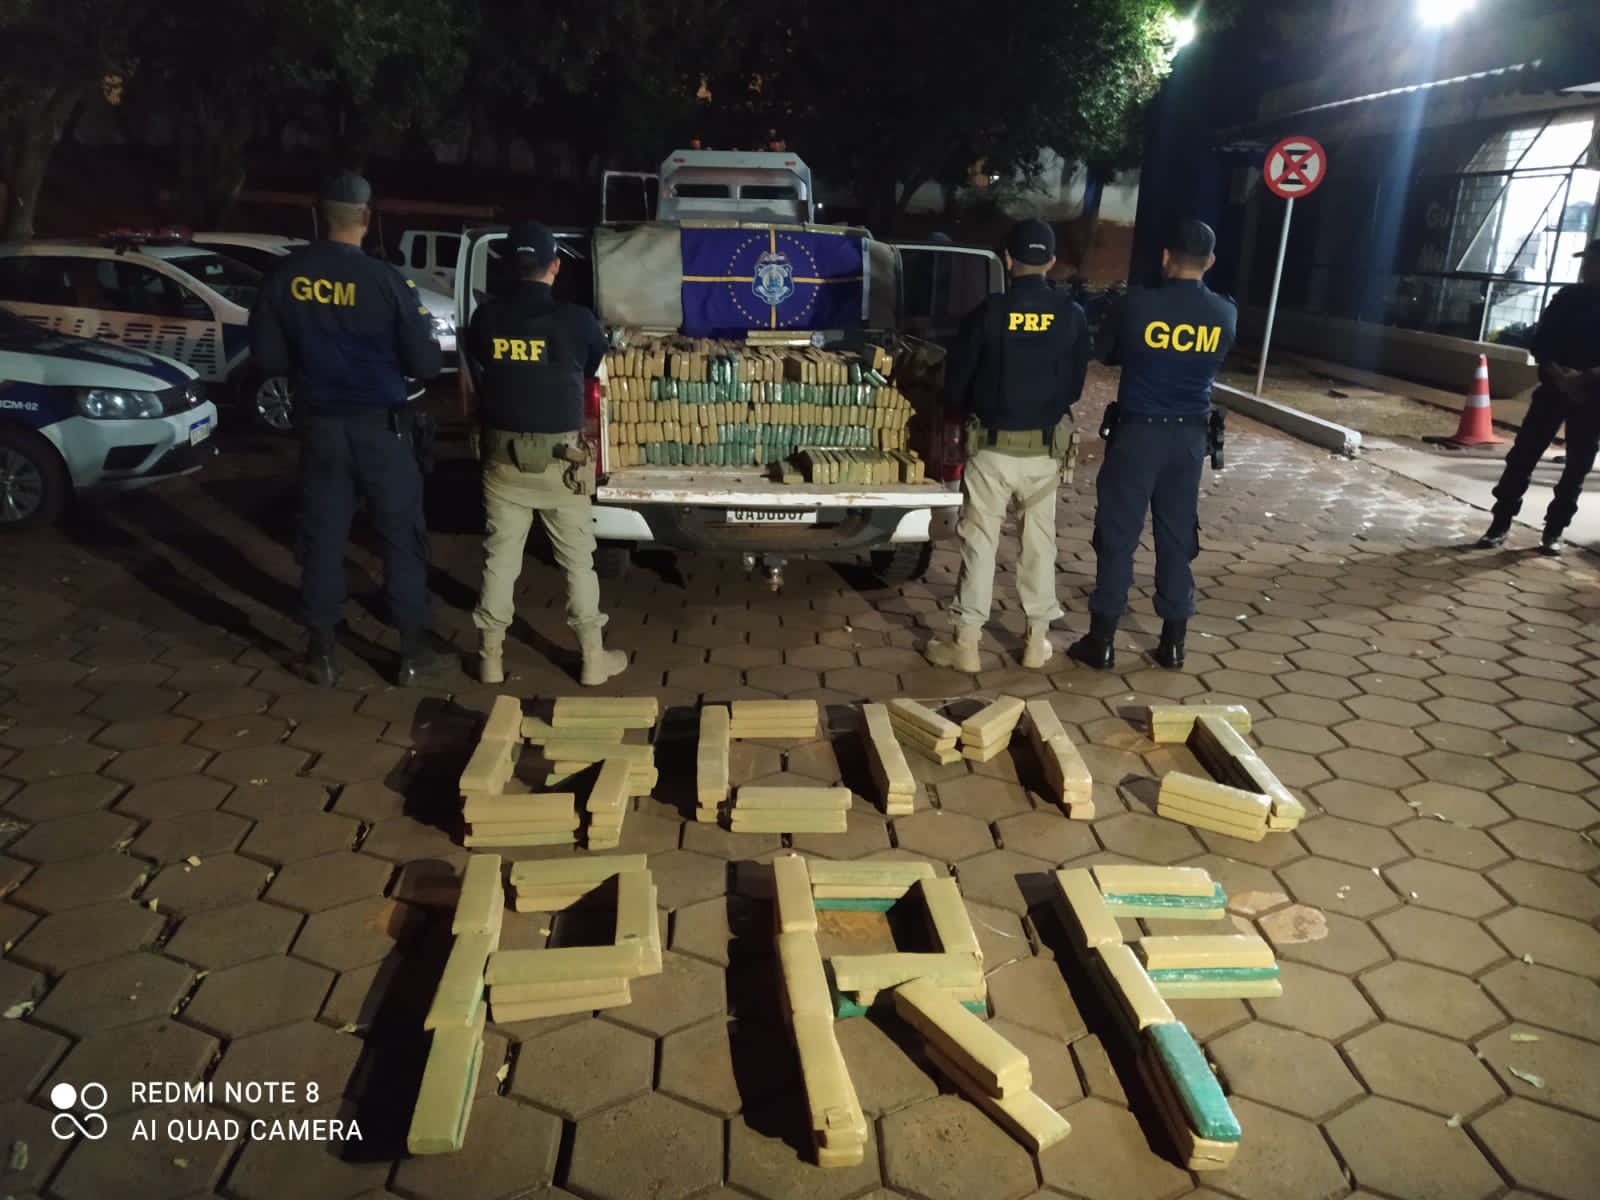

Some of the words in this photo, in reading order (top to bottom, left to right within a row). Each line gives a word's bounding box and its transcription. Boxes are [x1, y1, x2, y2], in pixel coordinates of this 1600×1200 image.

[291, 276, 356, 307] GCM
[1008, 313, 1055, 331] PRF
[1144, 320, 1221, 353] GCM
[492, 338, 545, 360] PRF
[407, 852, 1284, 1169] PRF
